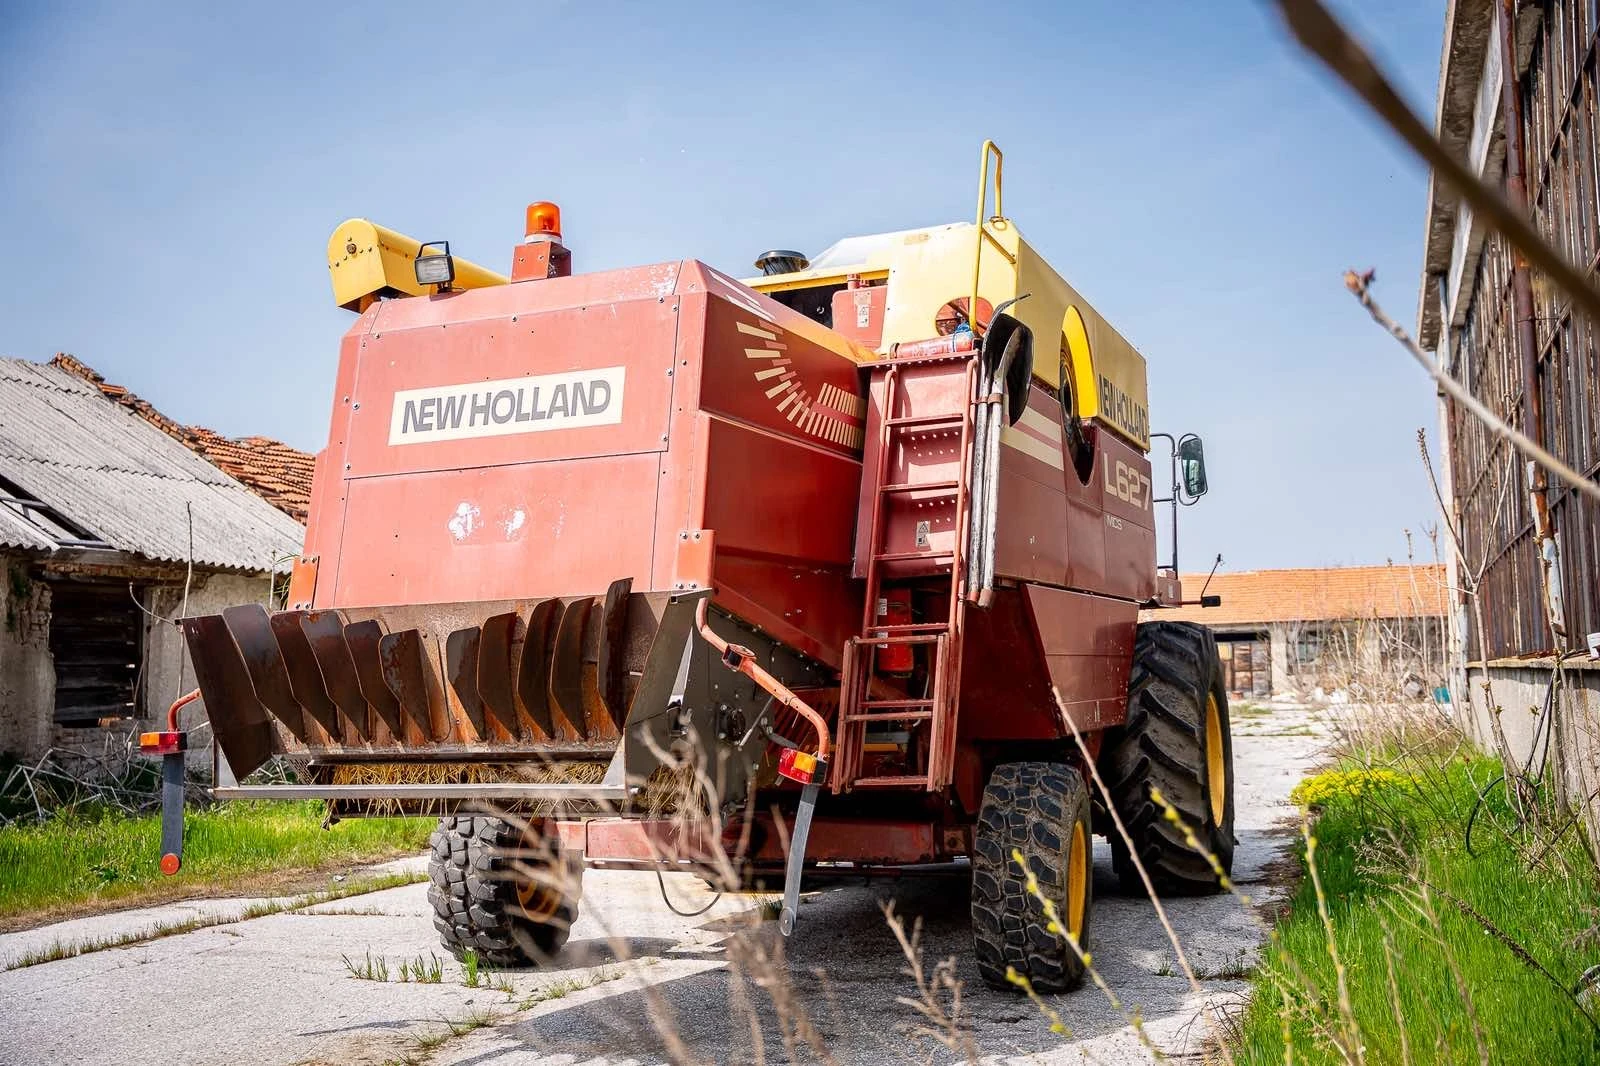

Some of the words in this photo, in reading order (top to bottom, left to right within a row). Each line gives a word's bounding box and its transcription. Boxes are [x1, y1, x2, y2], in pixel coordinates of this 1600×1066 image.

[402, 394, 467, 434] NEW
[469, 379, 611, 427] HOLLAND
[1099, 374, 1115, 421] NEW
[1115, 387, 1147, 443] HOLLAND
[1104, 452, 1150, 511] L627
